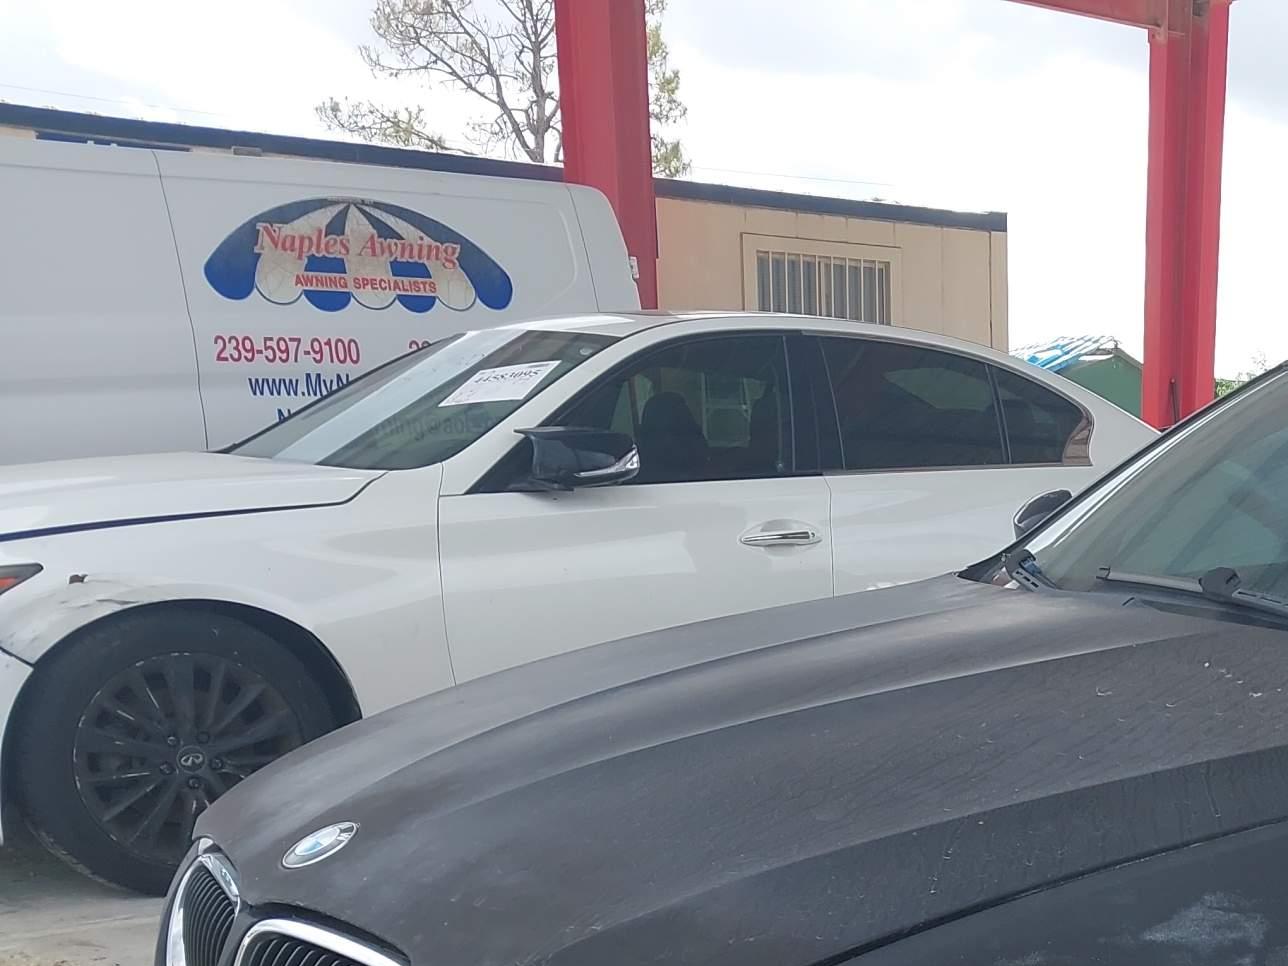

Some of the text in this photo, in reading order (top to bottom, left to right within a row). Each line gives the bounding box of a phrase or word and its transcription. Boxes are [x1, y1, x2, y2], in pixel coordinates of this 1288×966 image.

[258, 223, 459, 270] Naples Awning
[295, 275, 437, 294] AWNING SPECIALISTS
[213, 335, 361, 364] 239-597-9100
